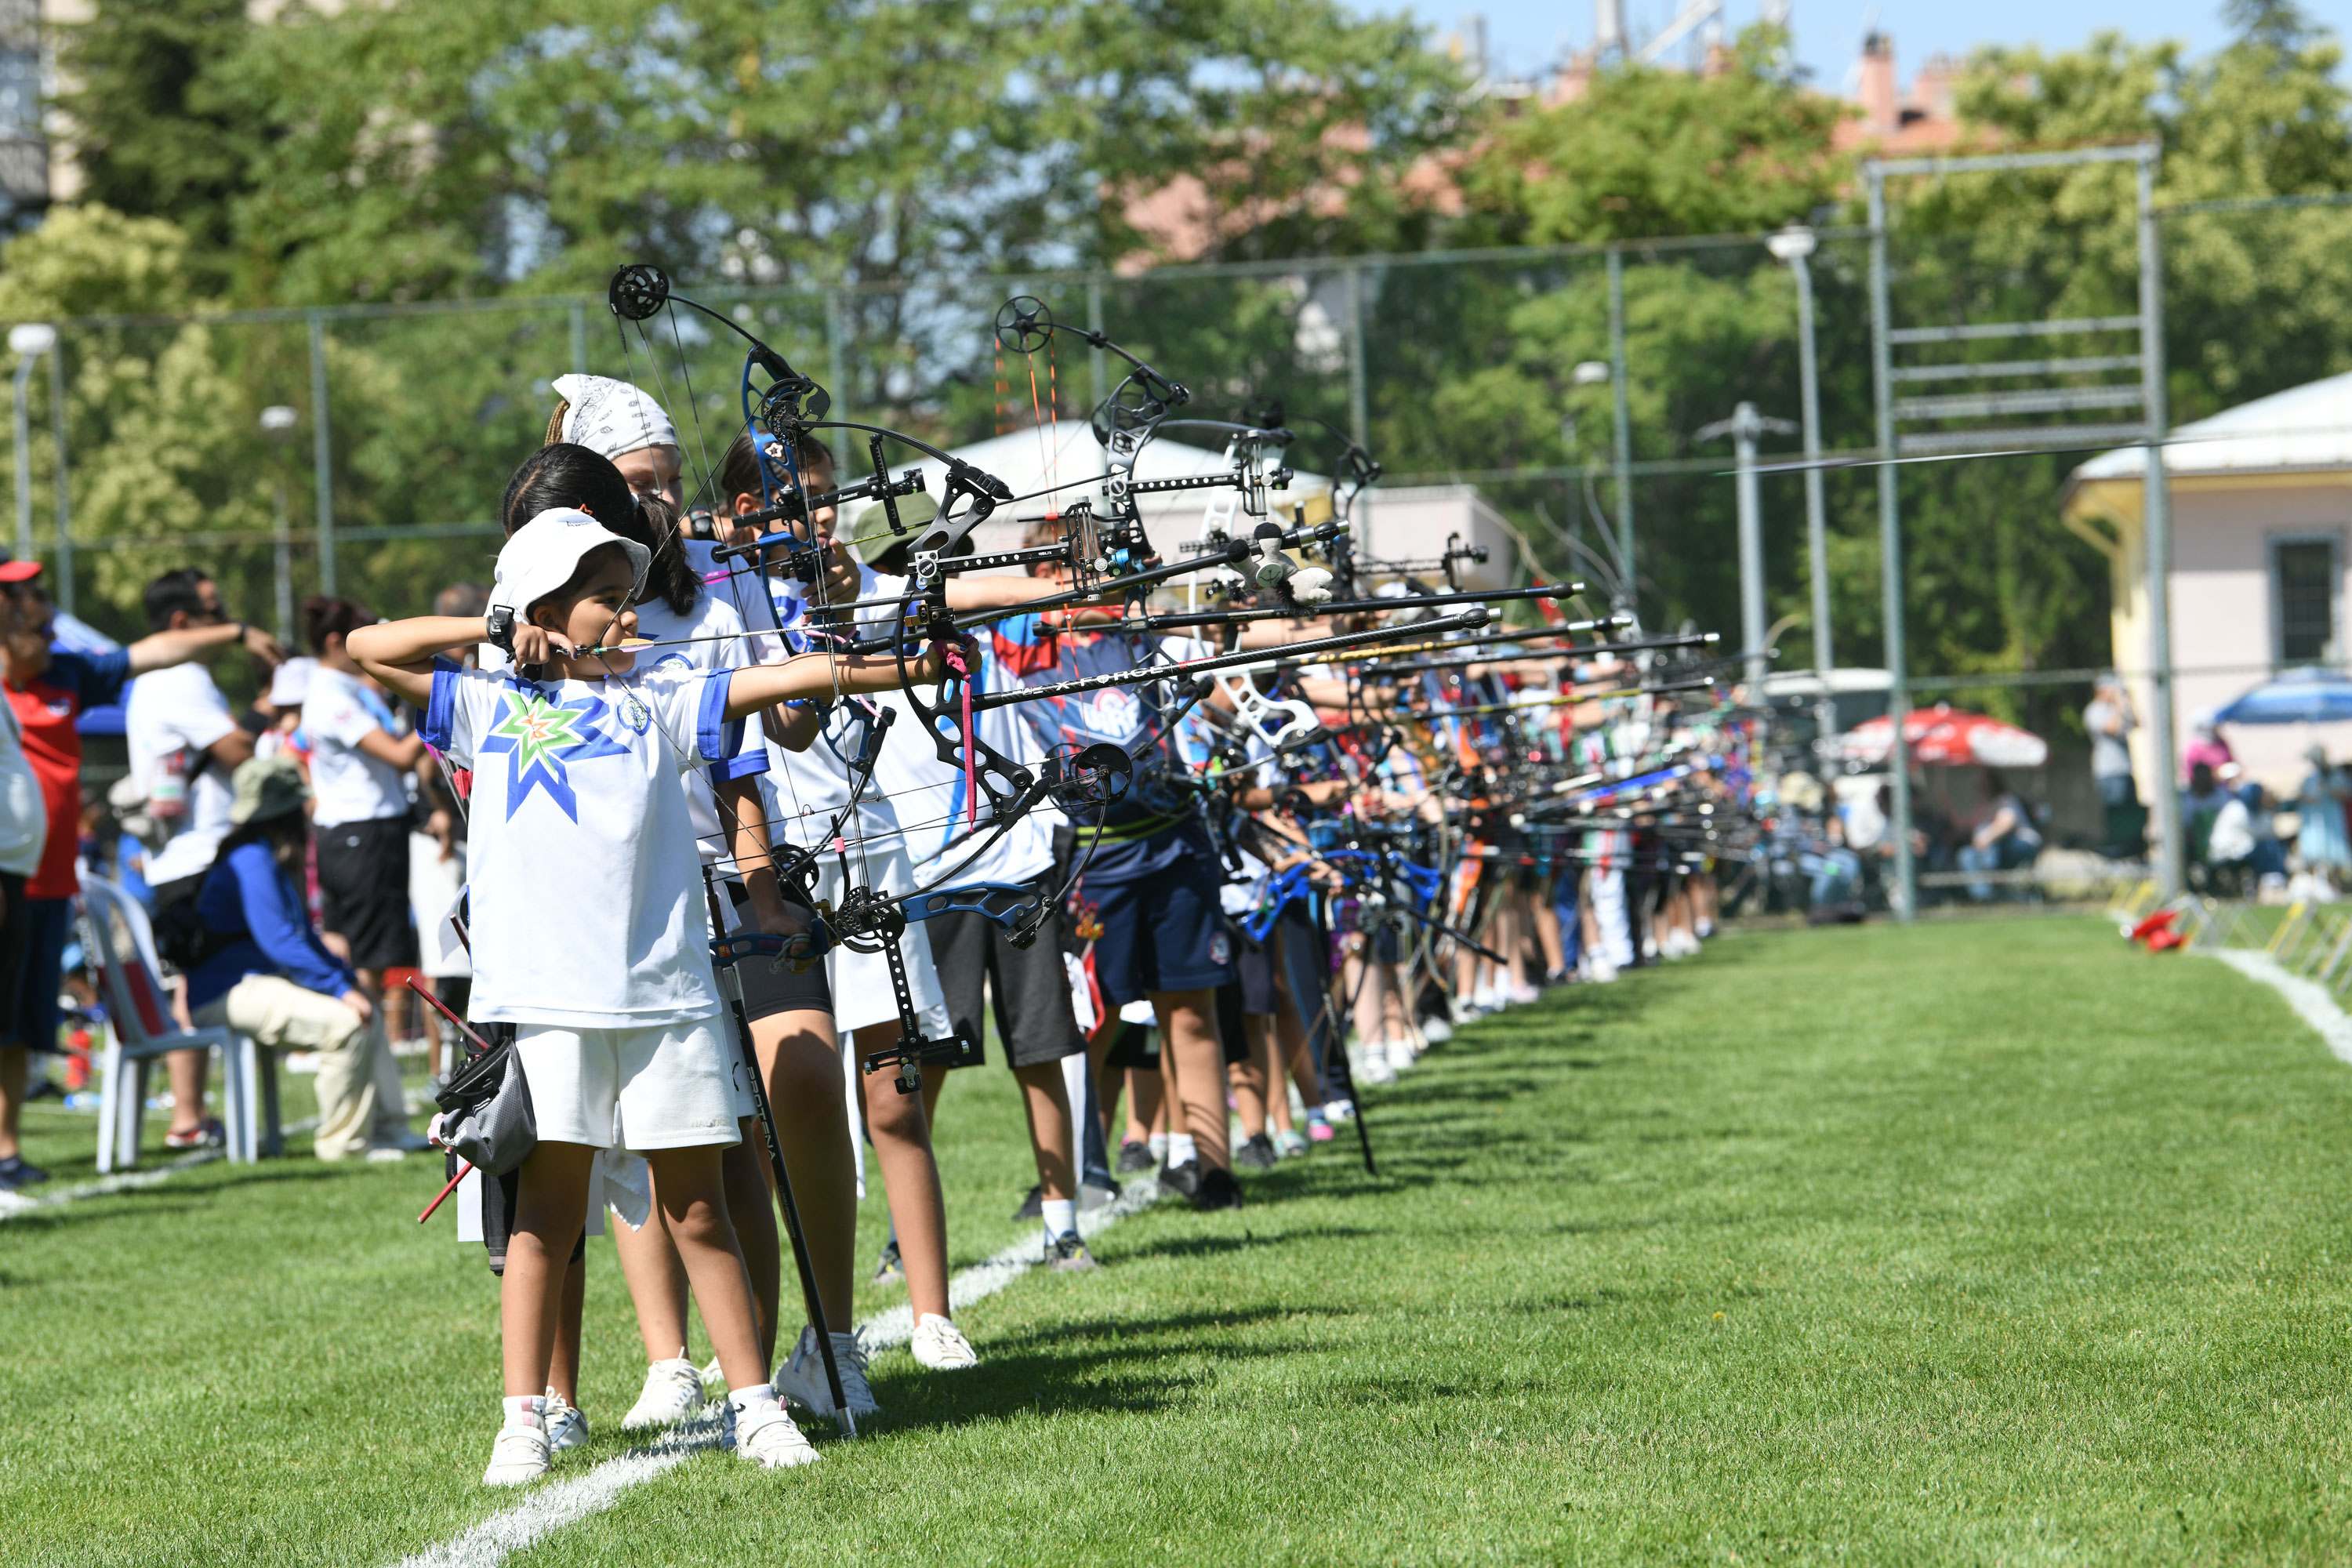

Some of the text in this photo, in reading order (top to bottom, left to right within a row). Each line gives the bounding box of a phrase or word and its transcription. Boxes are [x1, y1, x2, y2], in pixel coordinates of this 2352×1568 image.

[920, 562, 933, 574] HELIX
[1055, 681, 1070, 691] X
[905, 1014, 913, 1031] HELIX
[746, 1066, 776, 1161] PROTENA
